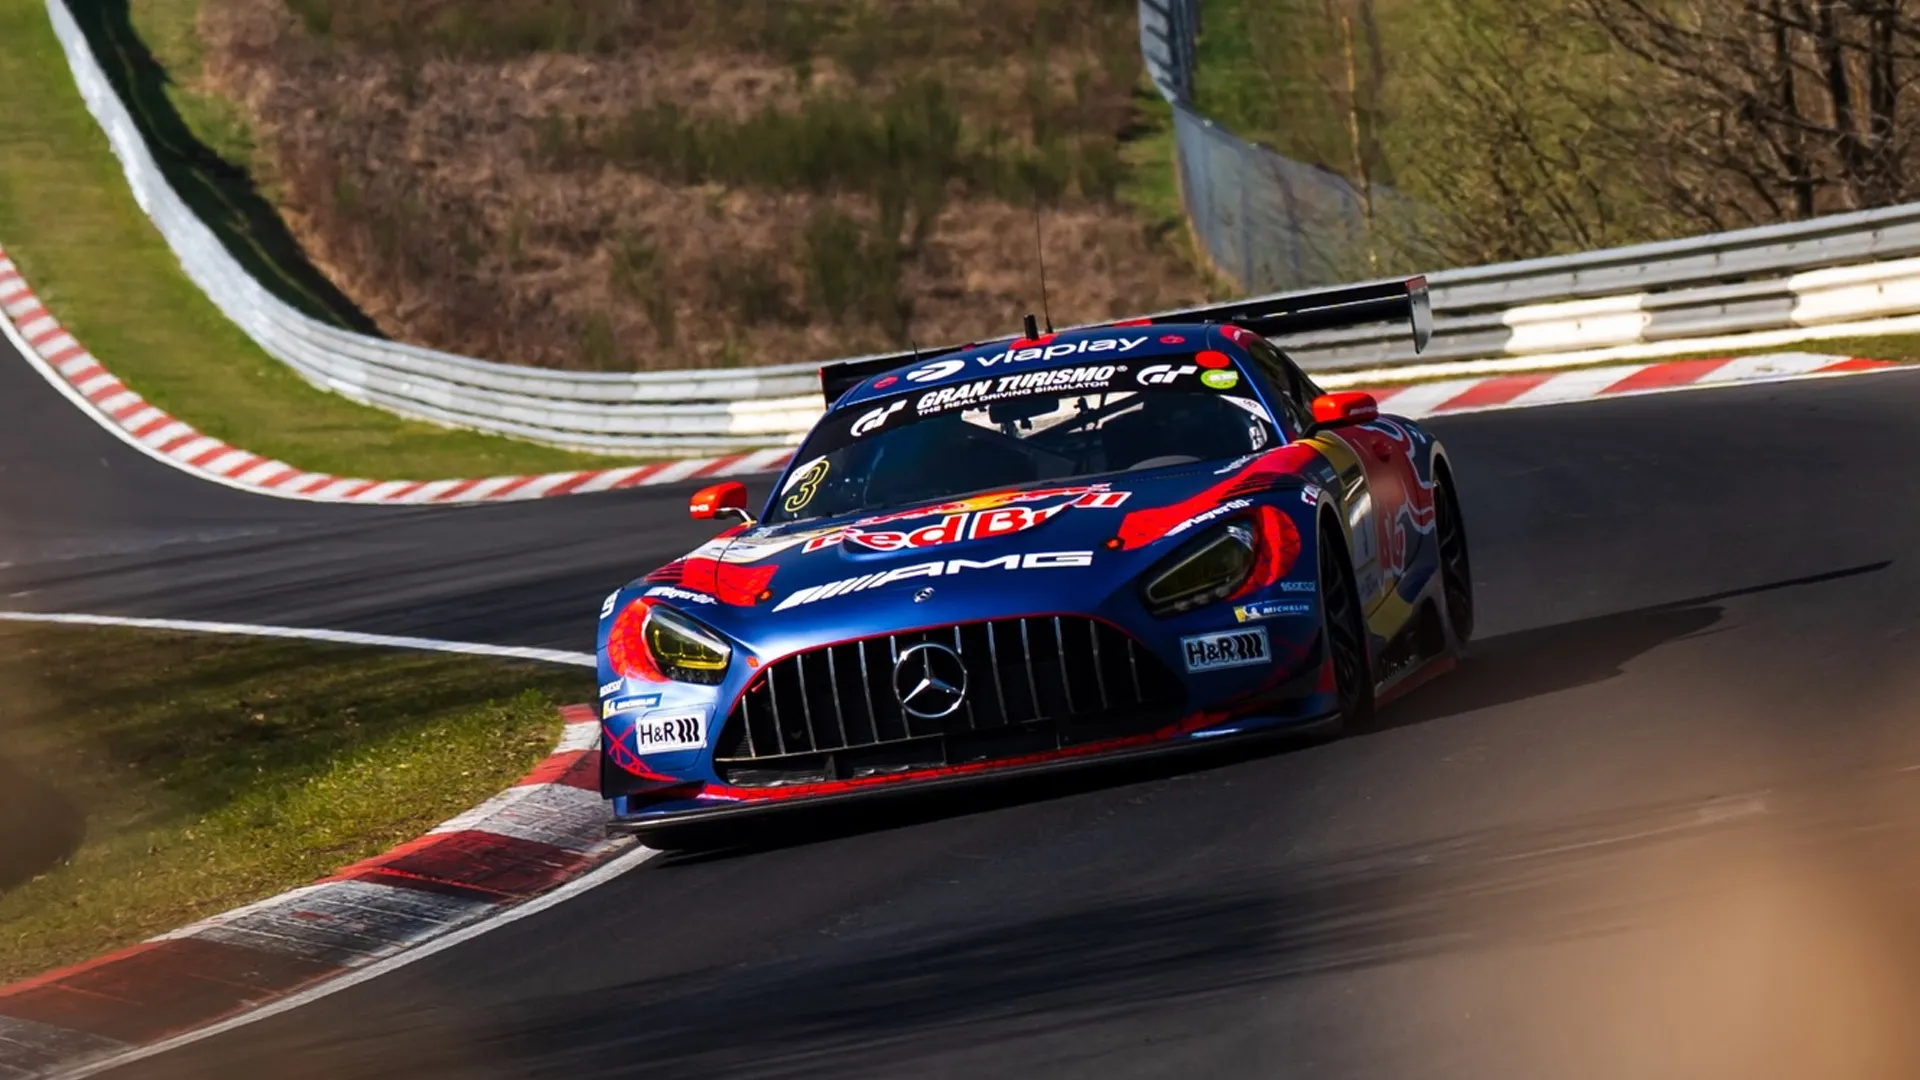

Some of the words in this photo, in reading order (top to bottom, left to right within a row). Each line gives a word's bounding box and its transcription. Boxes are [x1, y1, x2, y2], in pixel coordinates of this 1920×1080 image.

[977, 335, 1149, 367] viaplay
[917, 379, 993, 411] GRAN
[917, 404, 942, 417] THE
[944, 399, 978, 411] REAL
[979, 388, 1033, 402] DRIVING
[1034, 380, 1110, 394] SIMULATOR
[784, 460, 830, 512] 3
[1263, 604, 1310, 614] MICHELIN
[1186, 637, 1237, 666] H&R
[640, 721, 677, 745] H&R
